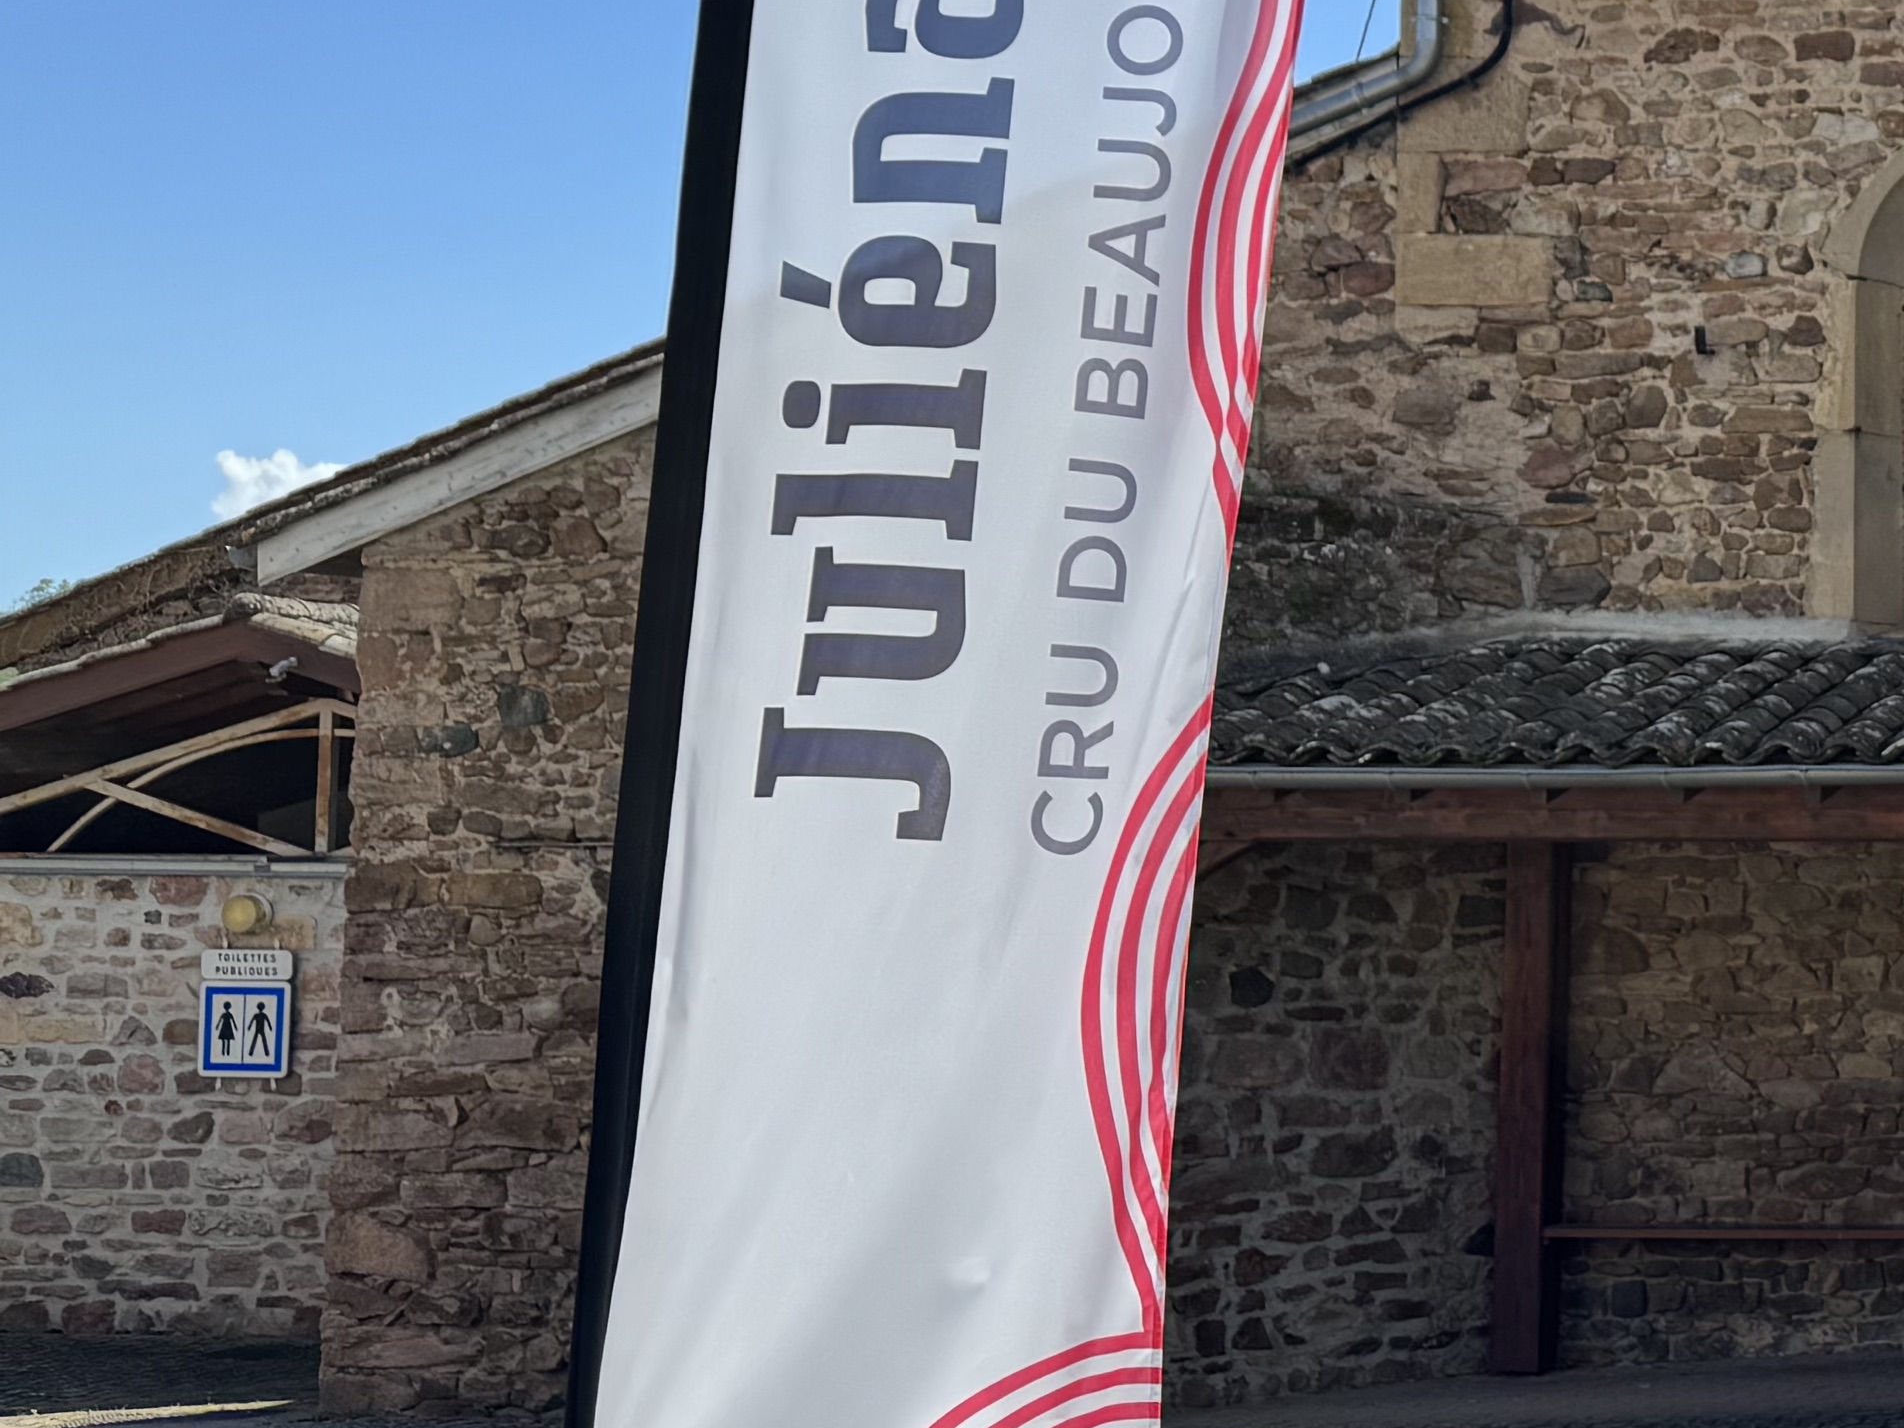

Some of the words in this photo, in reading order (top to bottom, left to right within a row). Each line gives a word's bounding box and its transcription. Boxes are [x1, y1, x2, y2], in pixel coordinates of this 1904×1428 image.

[1056, 457, 1140, 603] DU
[1030, 642, 1120, 856] CRU
[215, 966, 278, 976] PUBLIQUES
[217, 952, 277, 963] TOILETTES
